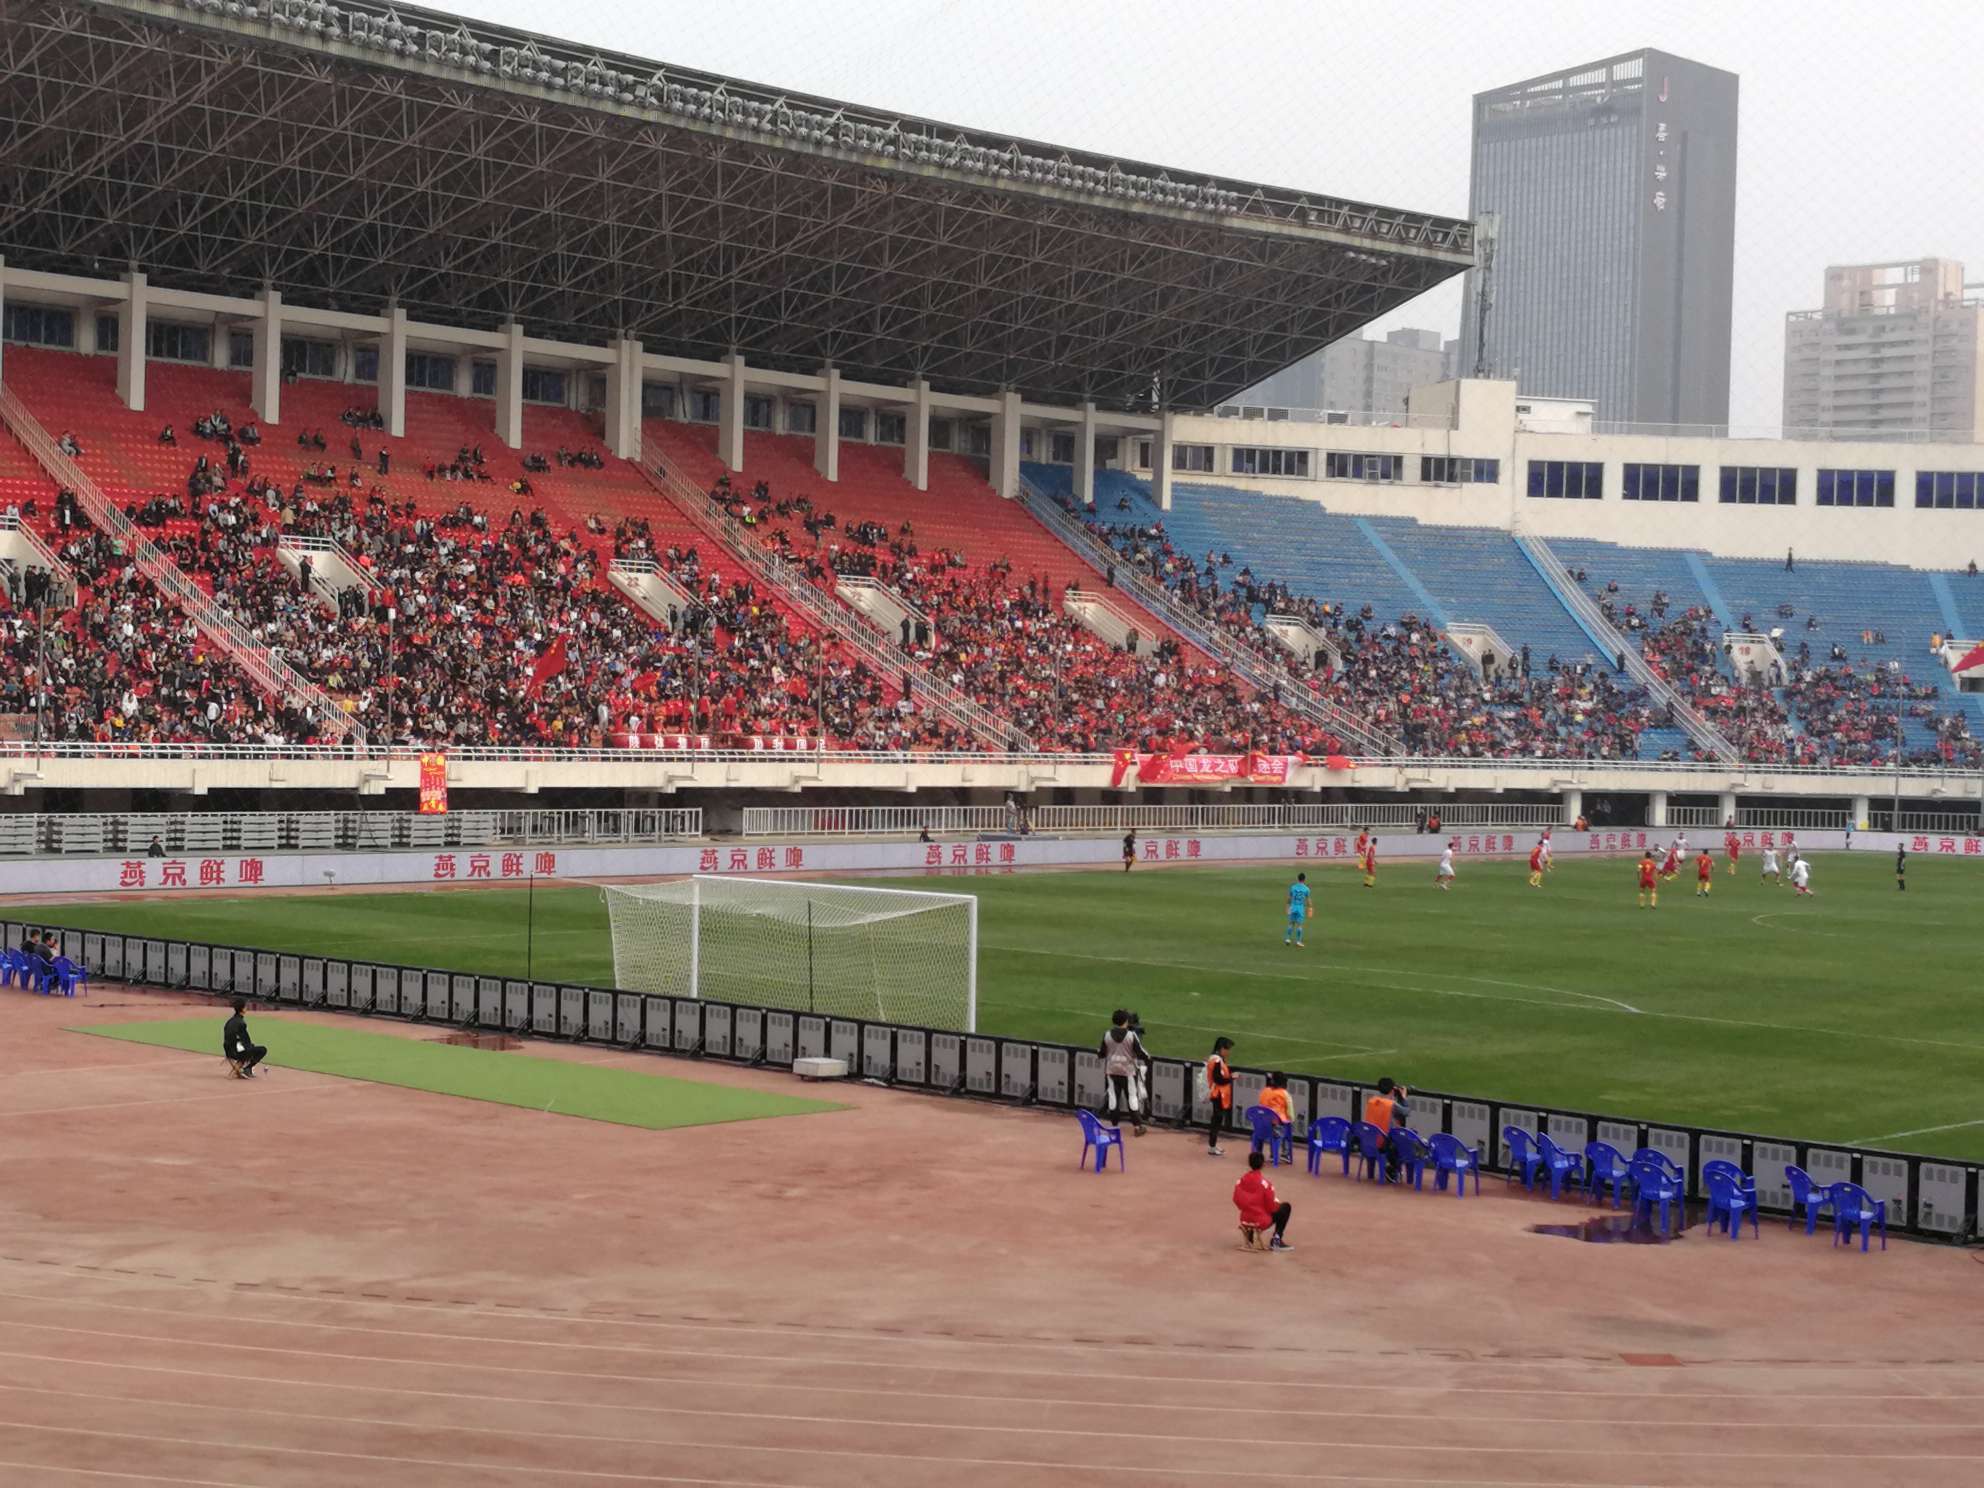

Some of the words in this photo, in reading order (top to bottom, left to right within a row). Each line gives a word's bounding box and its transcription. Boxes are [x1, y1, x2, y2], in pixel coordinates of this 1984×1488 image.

[432, 851, 557, 879] 燕京鲜啤
[698, 846, 804, 871] 燕京鲜啤
[925, 842, 1016, 865] 燕京鲜啤
[119, 858, 265, 887] 燕京鲜啤
